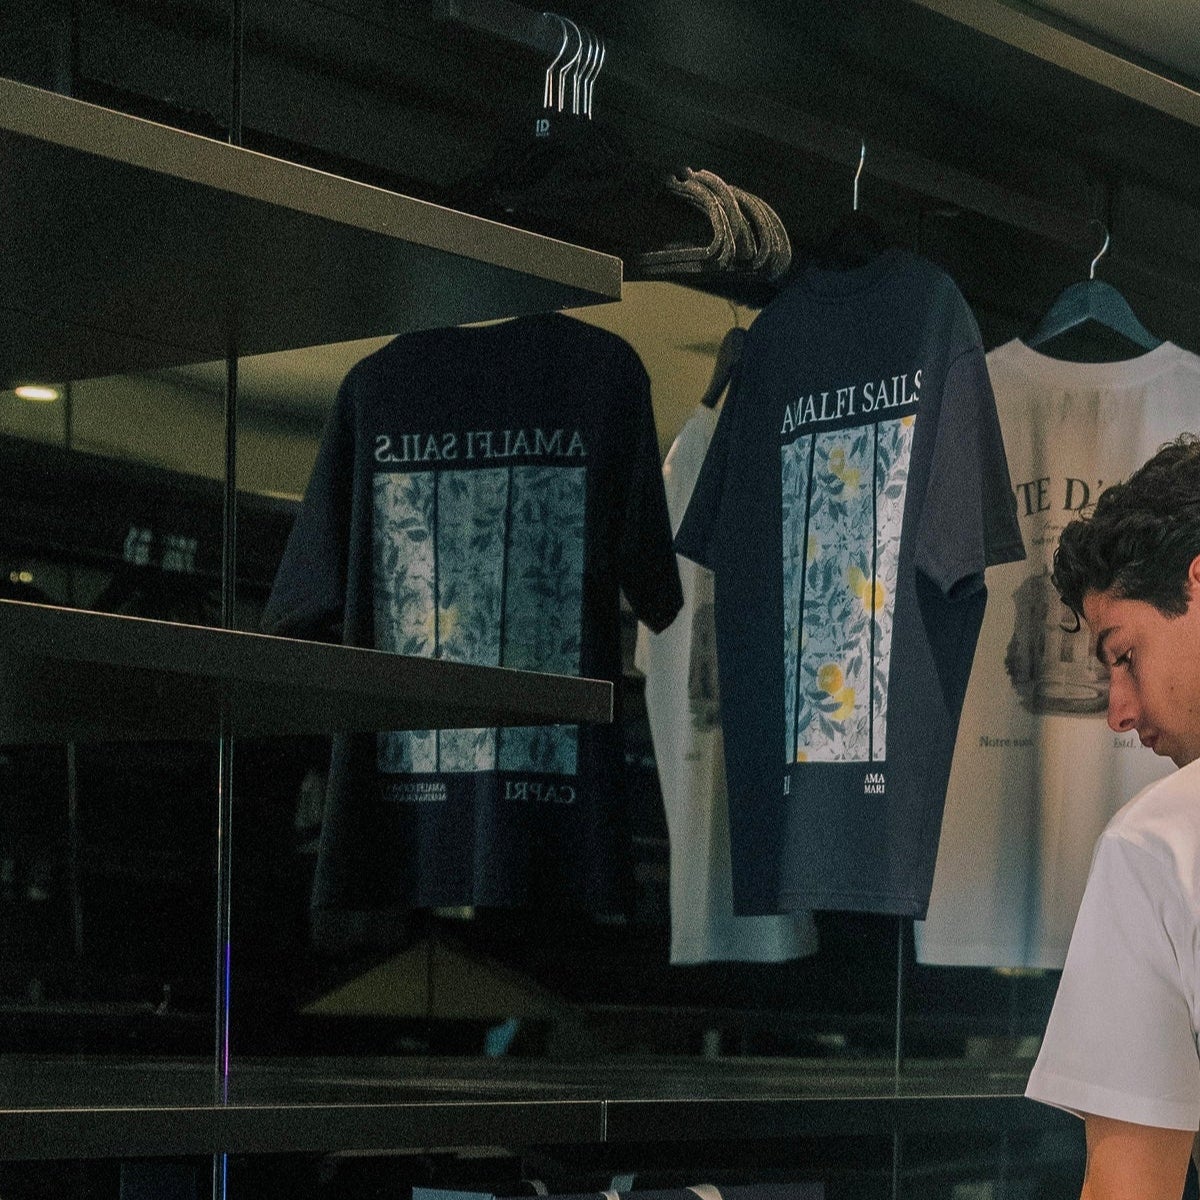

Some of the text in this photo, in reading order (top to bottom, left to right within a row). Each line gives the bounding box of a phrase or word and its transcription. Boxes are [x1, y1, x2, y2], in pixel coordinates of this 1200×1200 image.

[780, 369, 922, 434] AMALFI SAILS
[1016, 477, 1051, 517] TE
